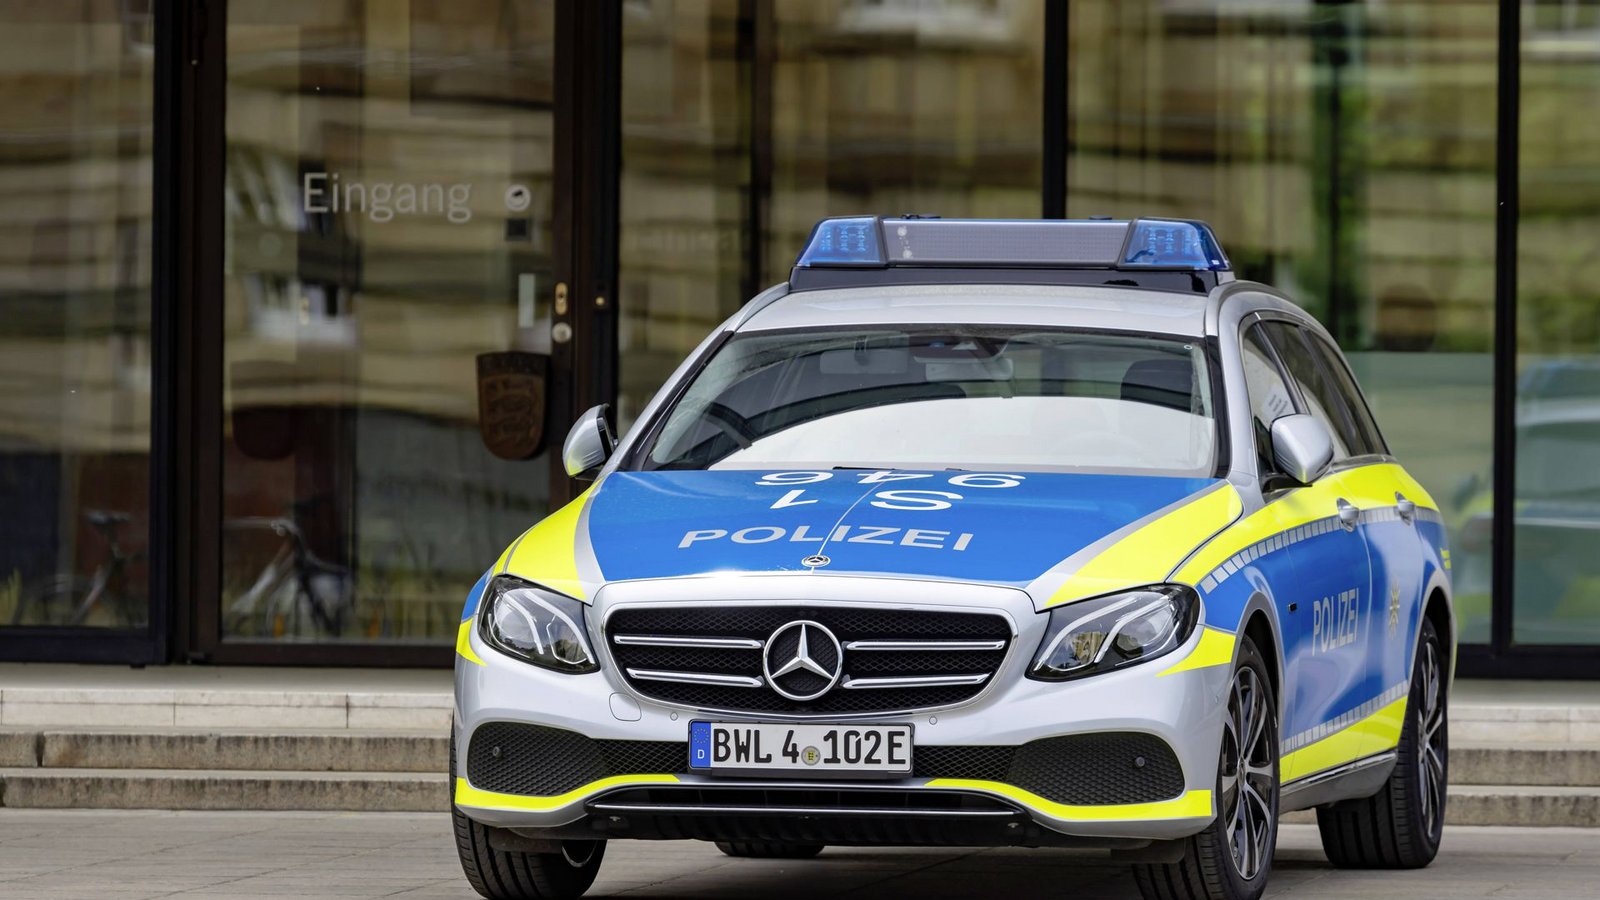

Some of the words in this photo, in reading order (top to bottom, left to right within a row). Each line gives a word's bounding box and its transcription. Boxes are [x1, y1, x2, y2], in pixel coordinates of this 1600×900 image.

[303, 172, 472, 223] Eingang
[755, 470, 1026, 488] 946
[678, 525, 974, 551] POLIZEI
[1312, 587, 1359, 656] POLIZEI
[697, 749, 705, 759] D
[713, 728, 772, 764] BWL
[782, 729, 799, 764] 4
[823, 731, 906, 765] 102E
